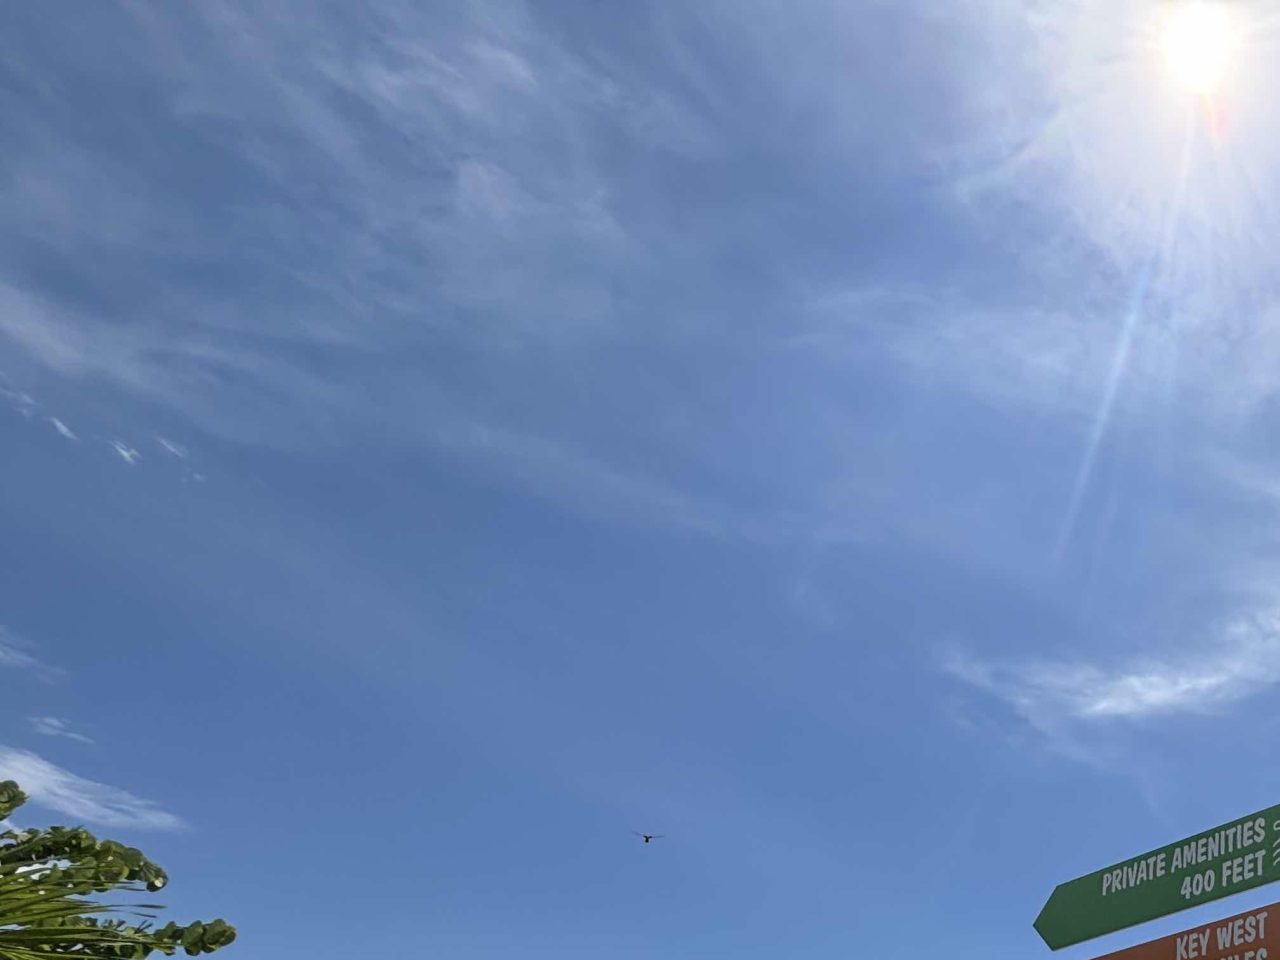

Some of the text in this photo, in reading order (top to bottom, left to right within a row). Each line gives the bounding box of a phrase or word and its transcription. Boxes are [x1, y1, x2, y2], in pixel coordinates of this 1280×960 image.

[1102, 818, 1266, 896] PRIVATE AMENITIES
[1180, 849, 1266, 899] 400 FEET
[1217, 912, 1268, 948] WEST
